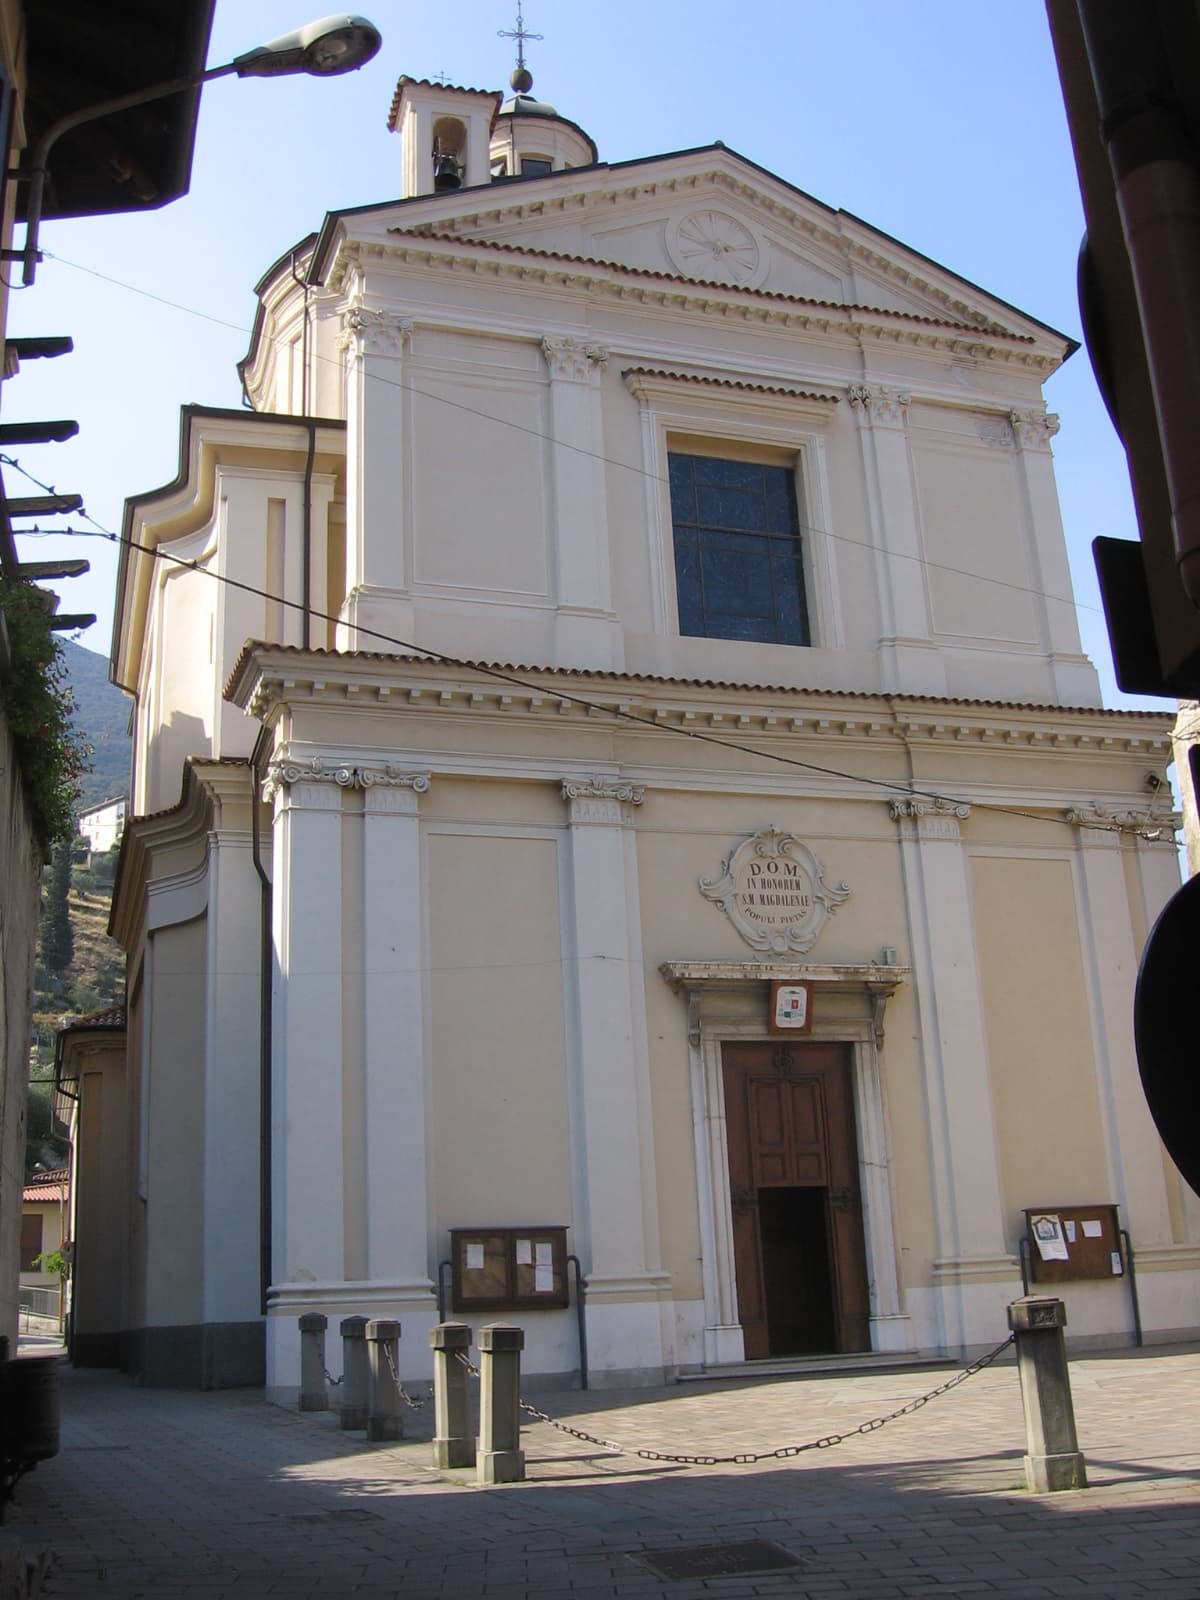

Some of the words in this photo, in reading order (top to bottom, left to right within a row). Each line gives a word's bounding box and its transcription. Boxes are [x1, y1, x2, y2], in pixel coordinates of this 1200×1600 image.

[747, 878, 756, 889] IN
[760, 878, 801, 891] HONOREM
[760, 894, 809, 907] MAGDALENAE
[744, 906, 776, 924] POPULI
[780, 909, 807, 924] PIETAS
